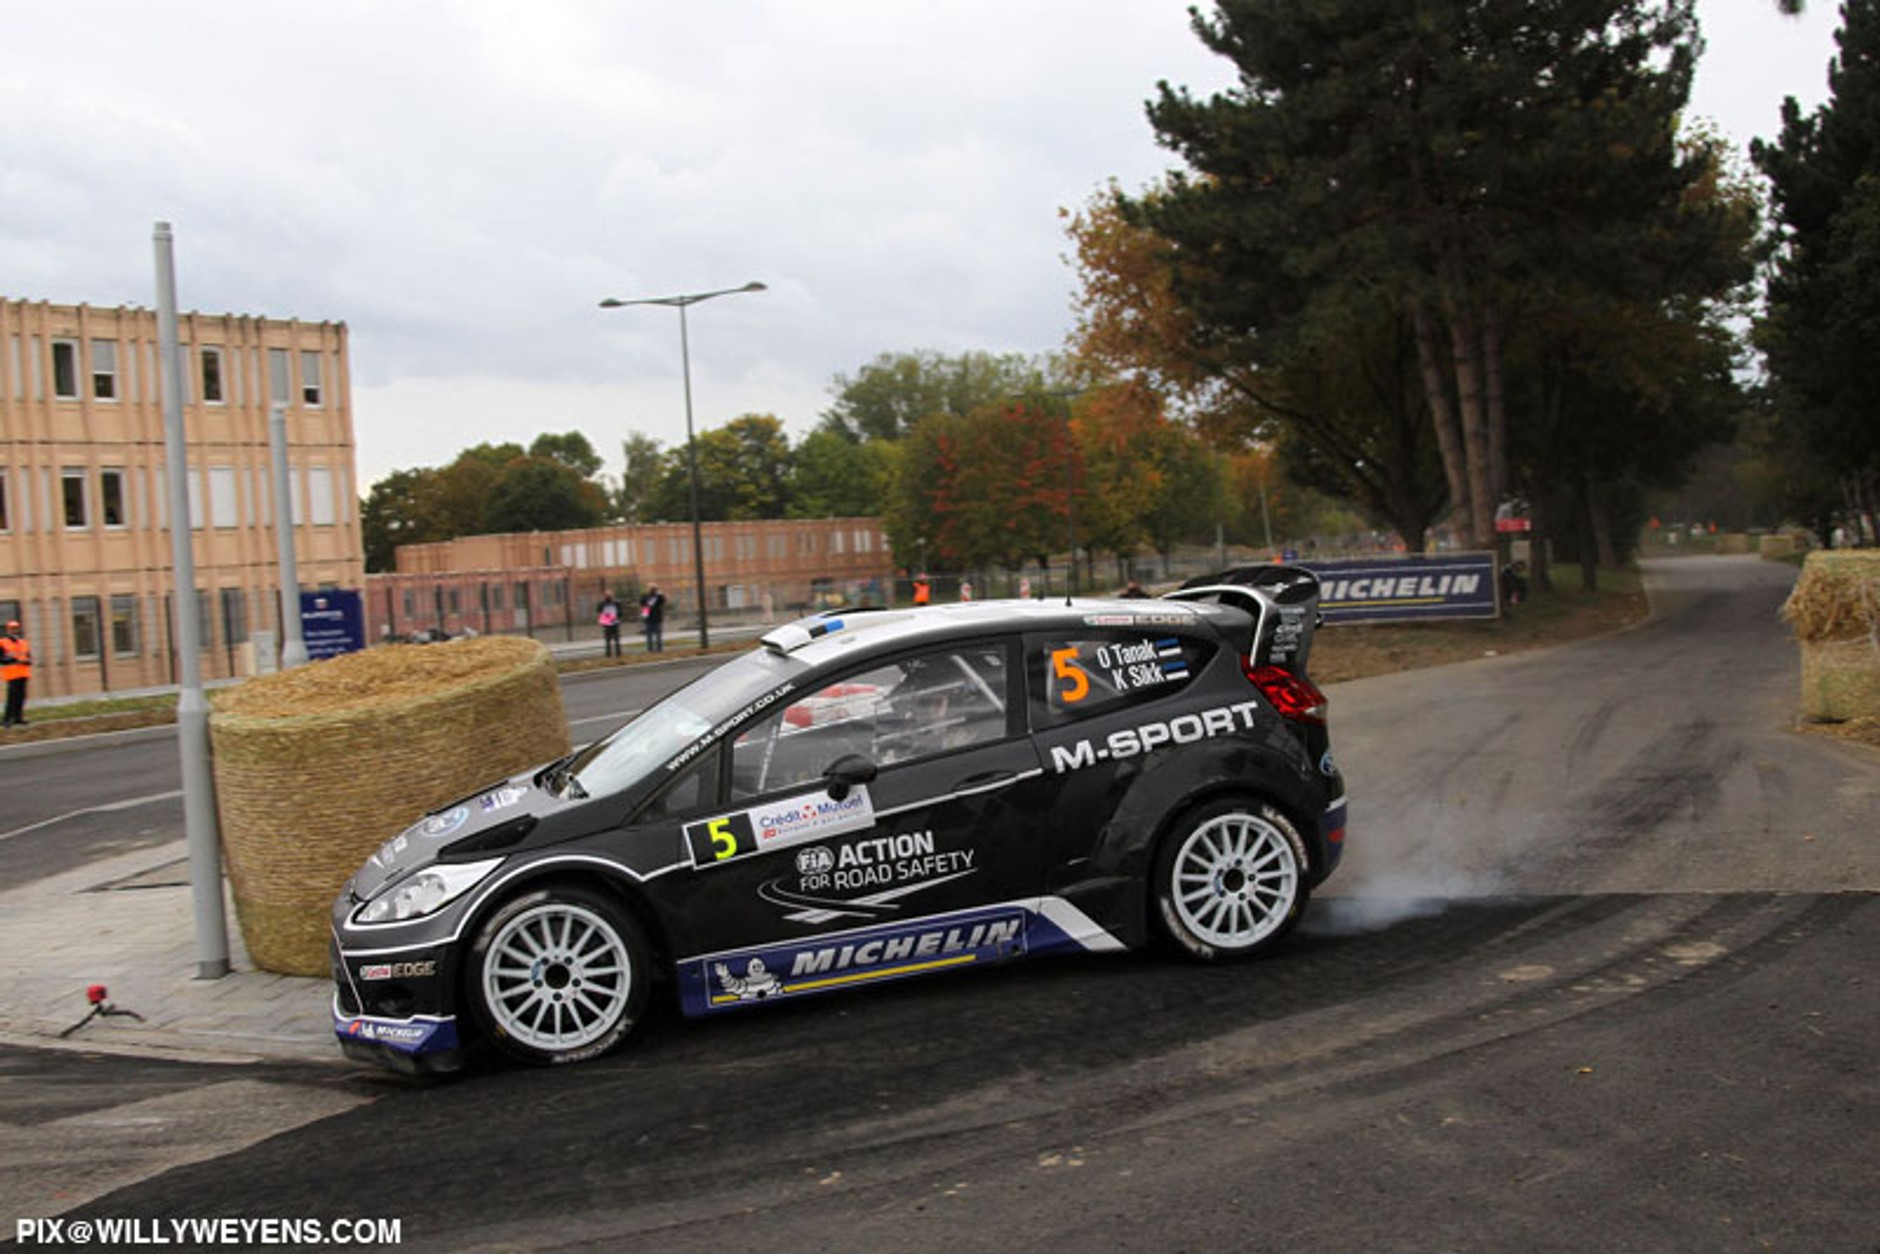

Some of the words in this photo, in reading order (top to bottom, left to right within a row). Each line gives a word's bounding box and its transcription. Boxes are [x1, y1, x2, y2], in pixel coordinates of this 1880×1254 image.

[1052, 646, 1090, 703] 5
[1097, 646, 1111, 668] O
[1111, 639, 1157, 665] Tanak
[1112, 669, 1129, 690] K
[1128, 661, 1164, 687] Sikk
[1051, 701, 1258, 774] M-SPORT
[707, 817, 737, 861] 5
[799, 852, 831, 870] FIA
[838, 830, 934, 868] ACTION
[800, 873, 832, 891] FOR
[834, 863, 892, 891] ROAD
[895, 849, 975, 880] SAFETY
[791, 919, 1020, 976] MICHELIN
[392, 961, 437, 978] EDGE
